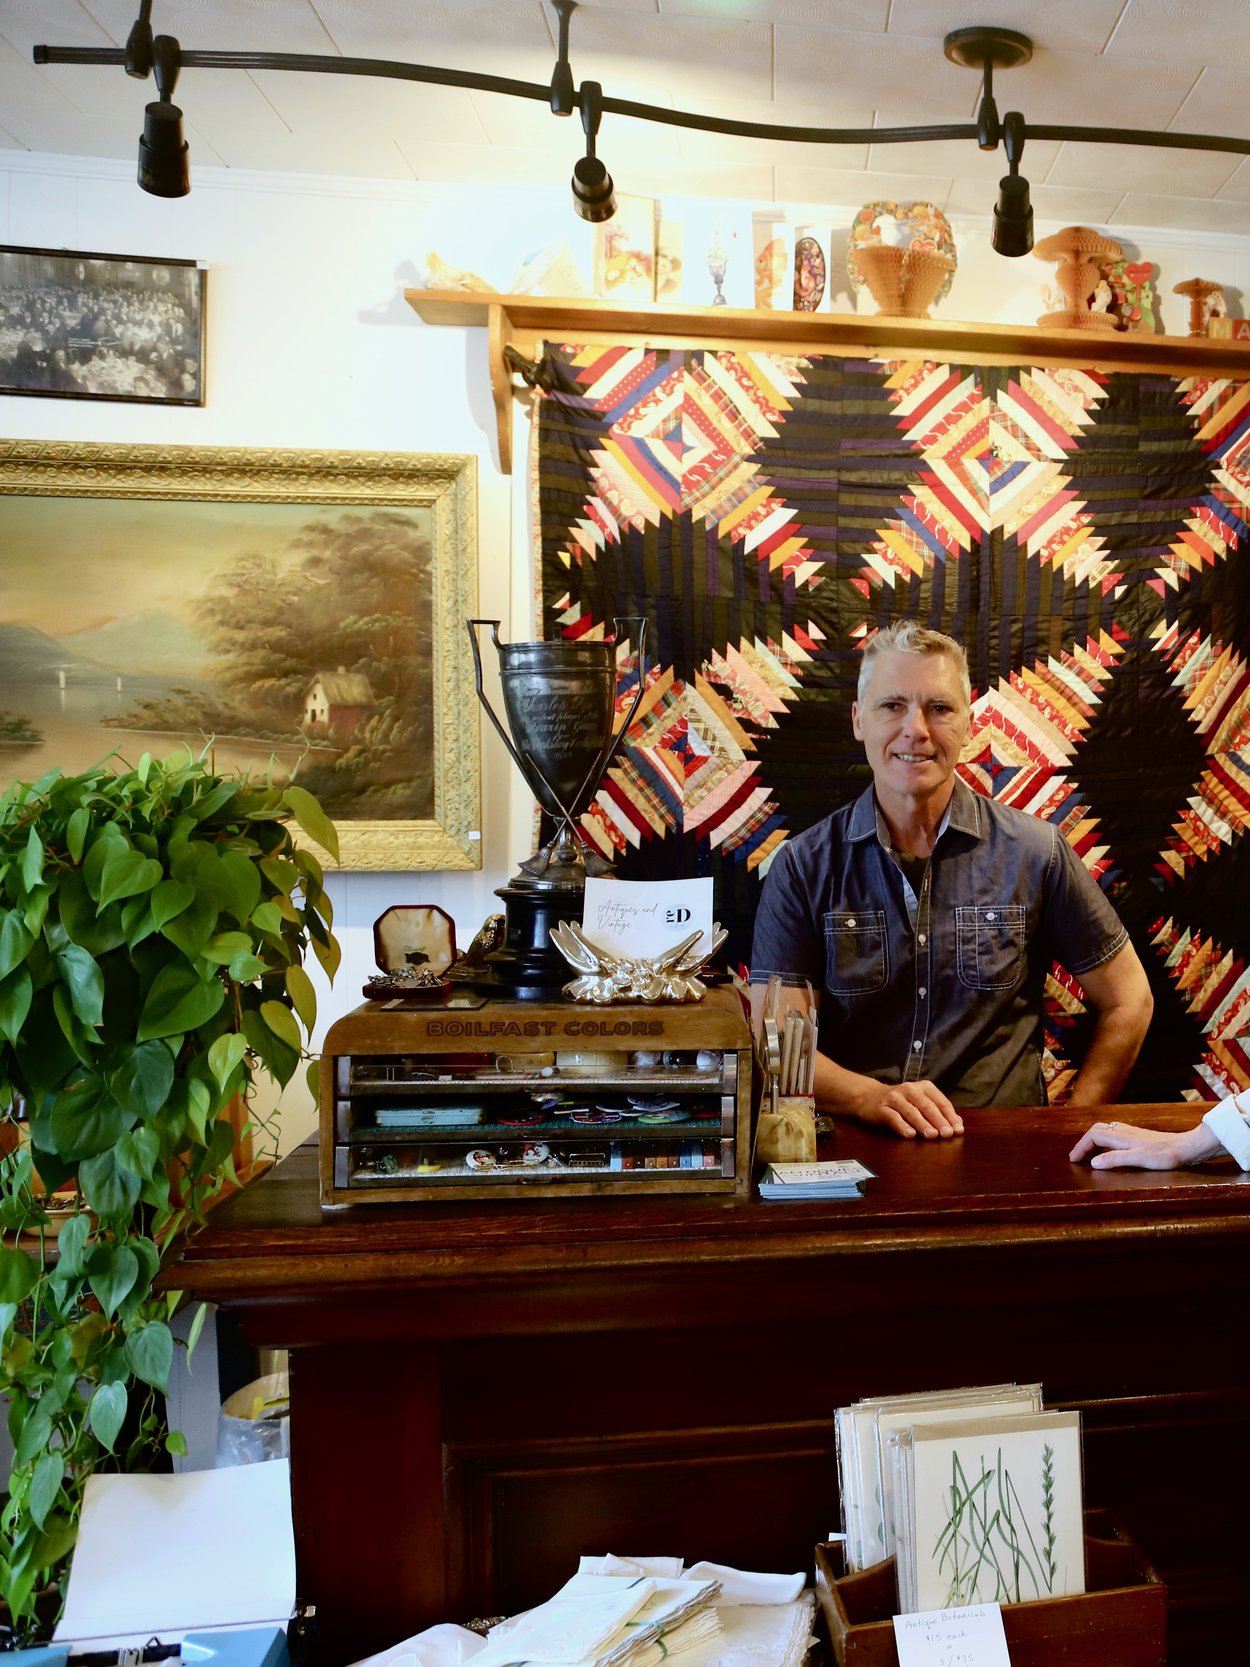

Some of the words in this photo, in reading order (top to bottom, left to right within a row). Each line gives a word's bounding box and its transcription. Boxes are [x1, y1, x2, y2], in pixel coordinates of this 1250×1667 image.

[598, 900, 639, 918] Antiques
[641, 902, 659, 915] and
[598, 915, 632, 934] Vintage
[427, 1021, 556, 1037] BOILFAST
[564, 1021, 665, 1036] COLORS
[905, 1619, 937, 1630] Antique
[926, 1632, 942, 1643] $15
[946, 1629, 968, 1641] each
